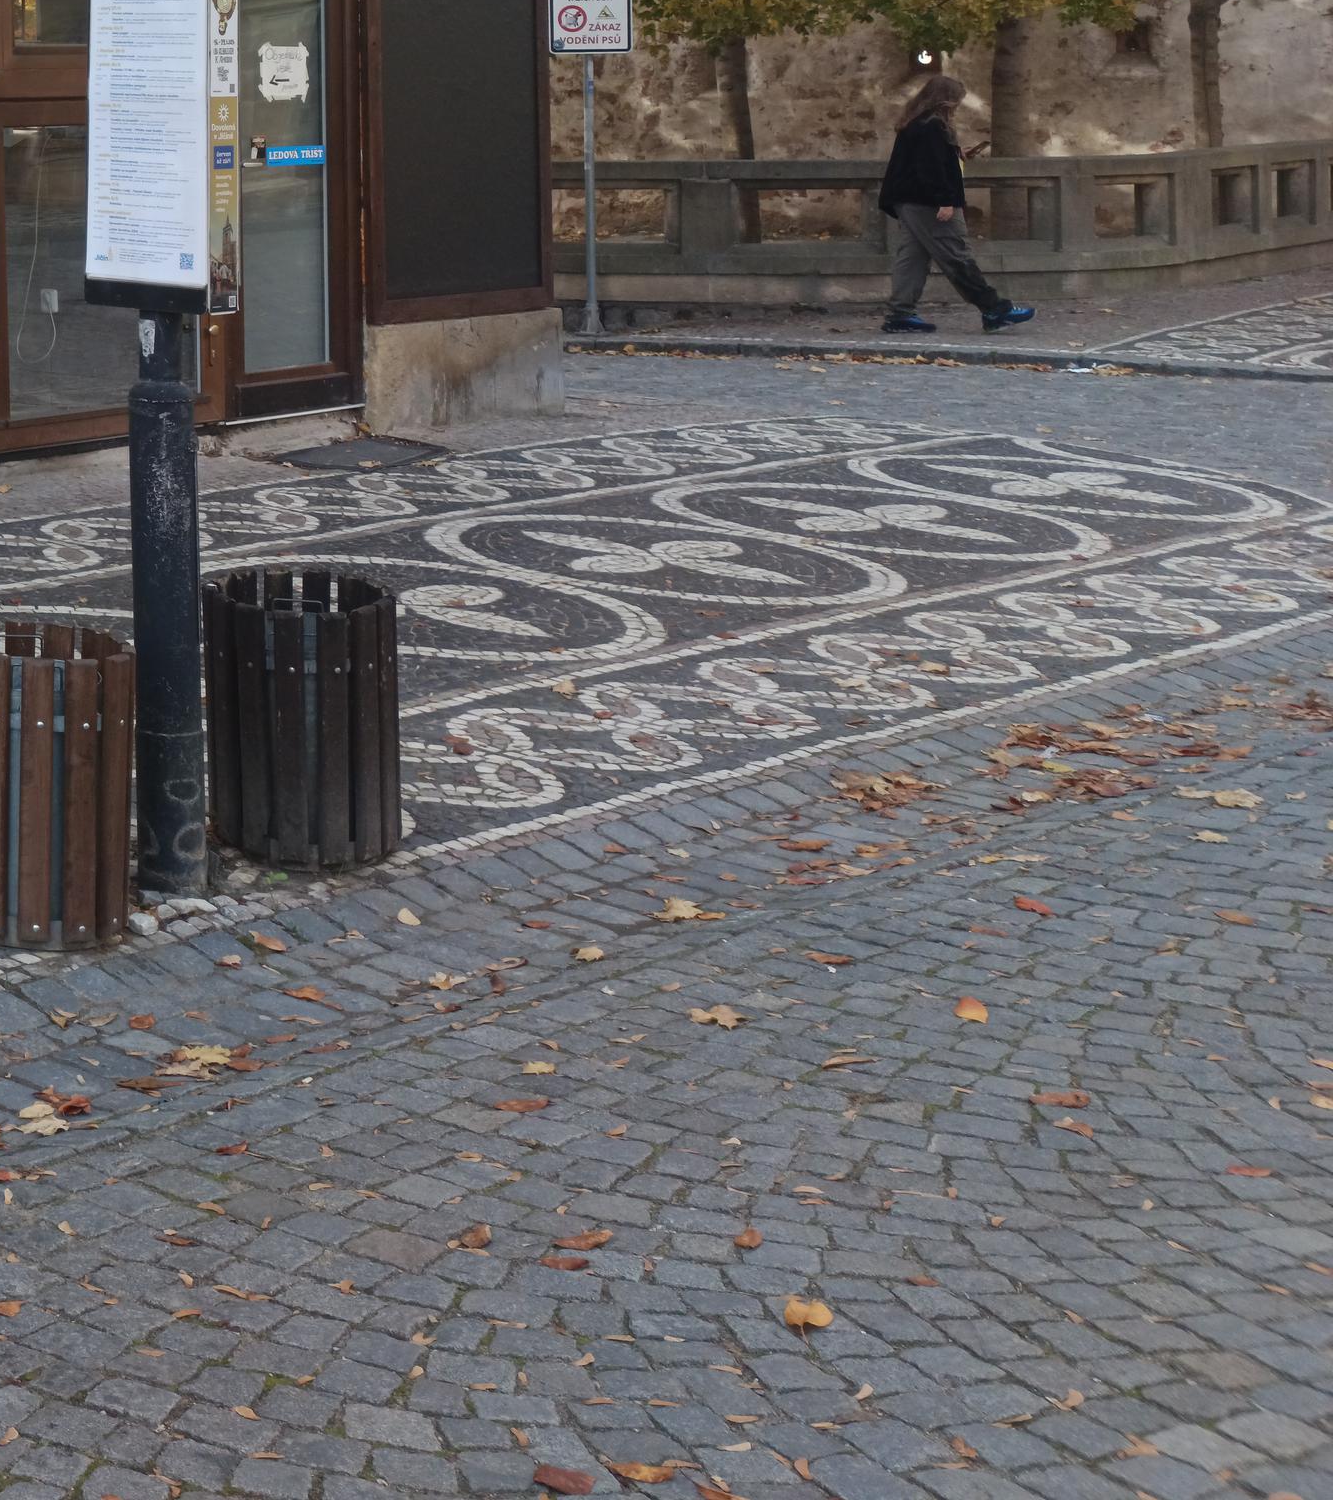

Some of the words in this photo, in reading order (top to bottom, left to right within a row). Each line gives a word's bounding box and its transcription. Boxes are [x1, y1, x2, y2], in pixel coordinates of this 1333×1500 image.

[588, 22, 621, 32] ZÁKAZ
[560, 35, 599, 44] VODĚNÍ
[602, 34, 621, 44] PSŮ
[269, 148, 298, 160] LEDOVÁ
